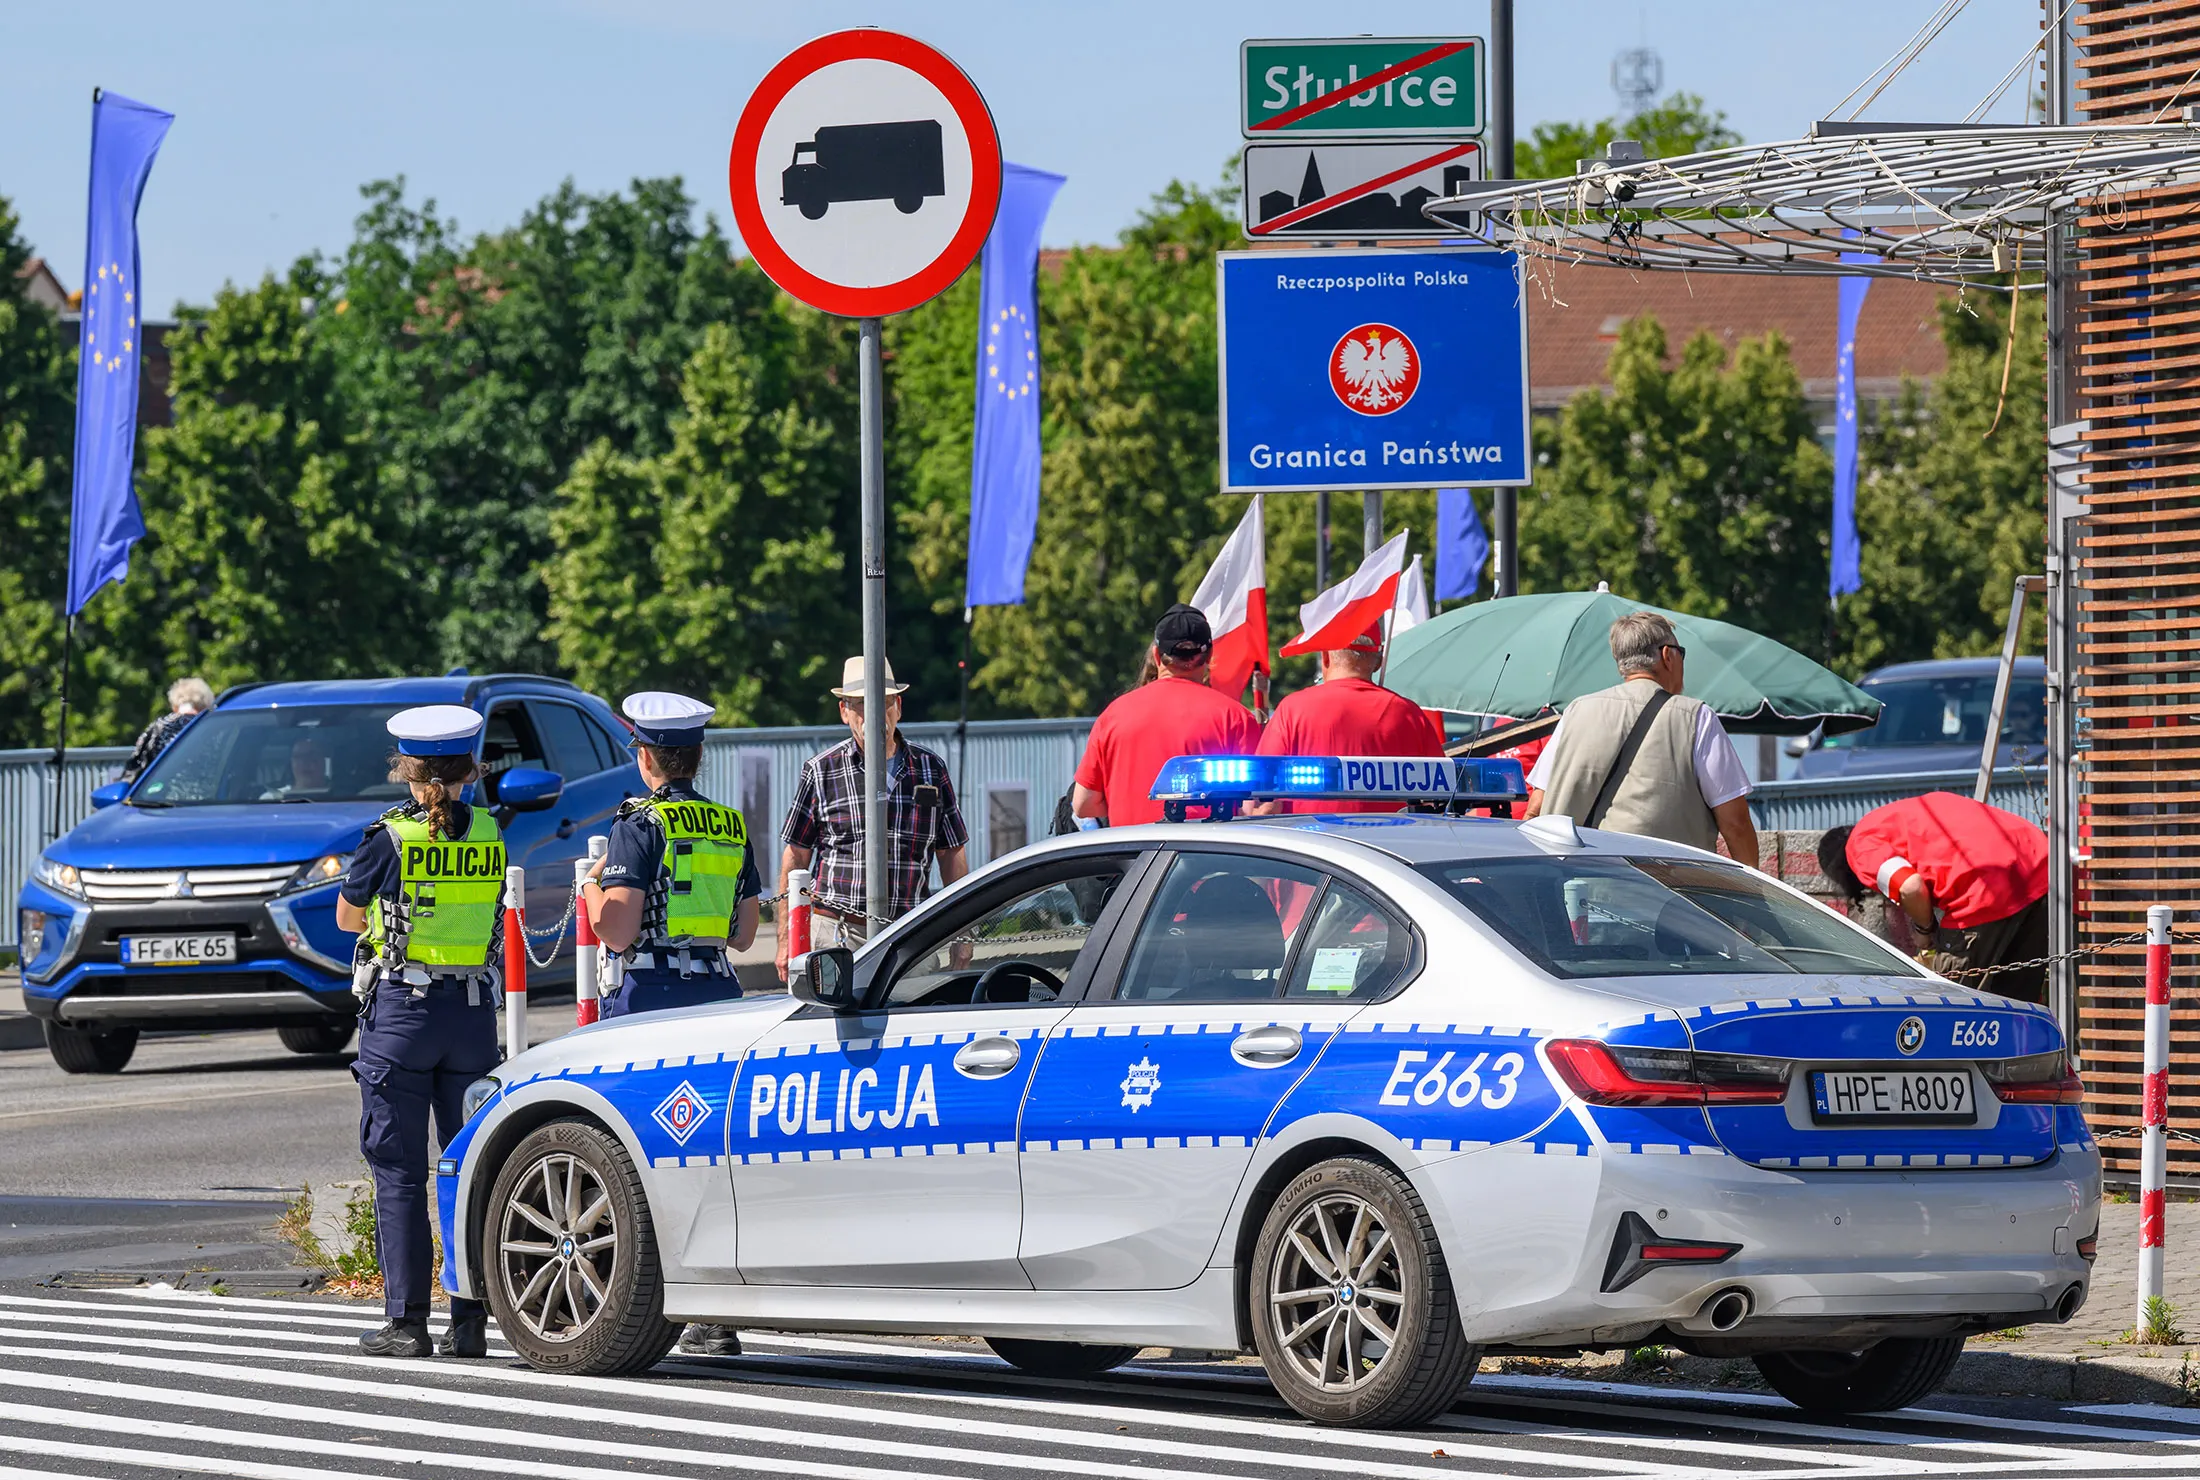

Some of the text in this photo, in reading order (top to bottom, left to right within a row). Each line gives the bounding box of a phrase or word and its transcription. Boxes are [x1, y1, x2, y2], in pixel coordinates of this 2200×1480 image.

[1263, 64, 1457, 109] Słubice
[1277, 270, 1469, 292] Rzeczpospolita Polska
[1249, 440, 1502, 469] Granica Państwa
[1347, 761, 1450, 792] POLICJA
[662, 805, 744, 840] POLICJA
[407, 846, 502, 877] POLICJA
[138, 938, 227, 959] FF KE 65
[1951, 1020, 2000, 1047] E663
[1379, 1050, 1525, 1110] E663
[1834, 1076, 1965, 1112] HPE A809
[677, 1104, 687, 1121] R
[749, 1063, 940, 1138] POLICJA
[1816, 1100, 1828, 1110] PL
[600, 1158, 627, 1221] KUMHO
[1277, 1172, 1323, 1212] KUMHO
